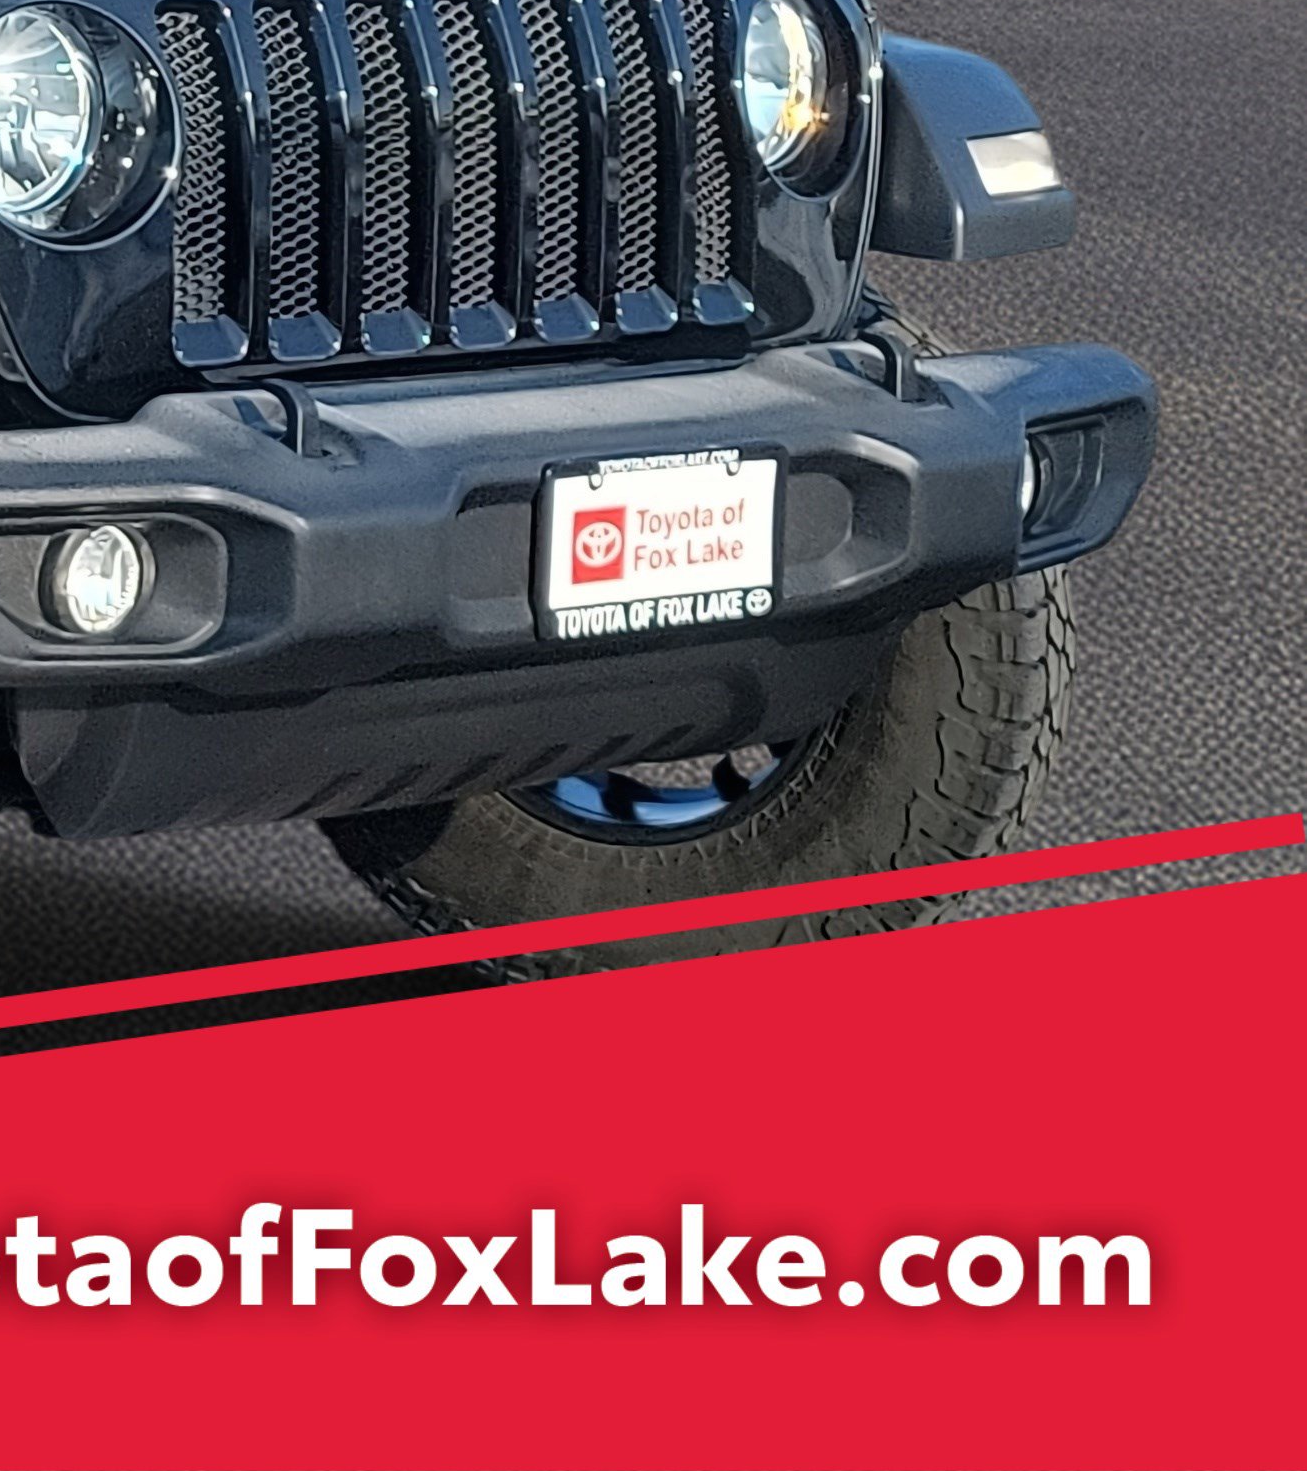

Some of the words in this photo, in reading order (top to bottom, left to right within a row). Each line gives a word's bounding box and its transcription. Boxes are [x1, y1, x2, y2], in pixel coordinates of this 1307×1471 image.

[637, 505, 713, 539] Toyota
[723, 498, 744, 525] of
[634, 545, 677, 571] Fox
[687, 536, 743, 564] Lake
[556, 604, 627, 639] TOYOTA
[629, 600, 654, 630] OF
[657, 596, 694, 628] FOX
[696, 591, 743, 620] LAKE
